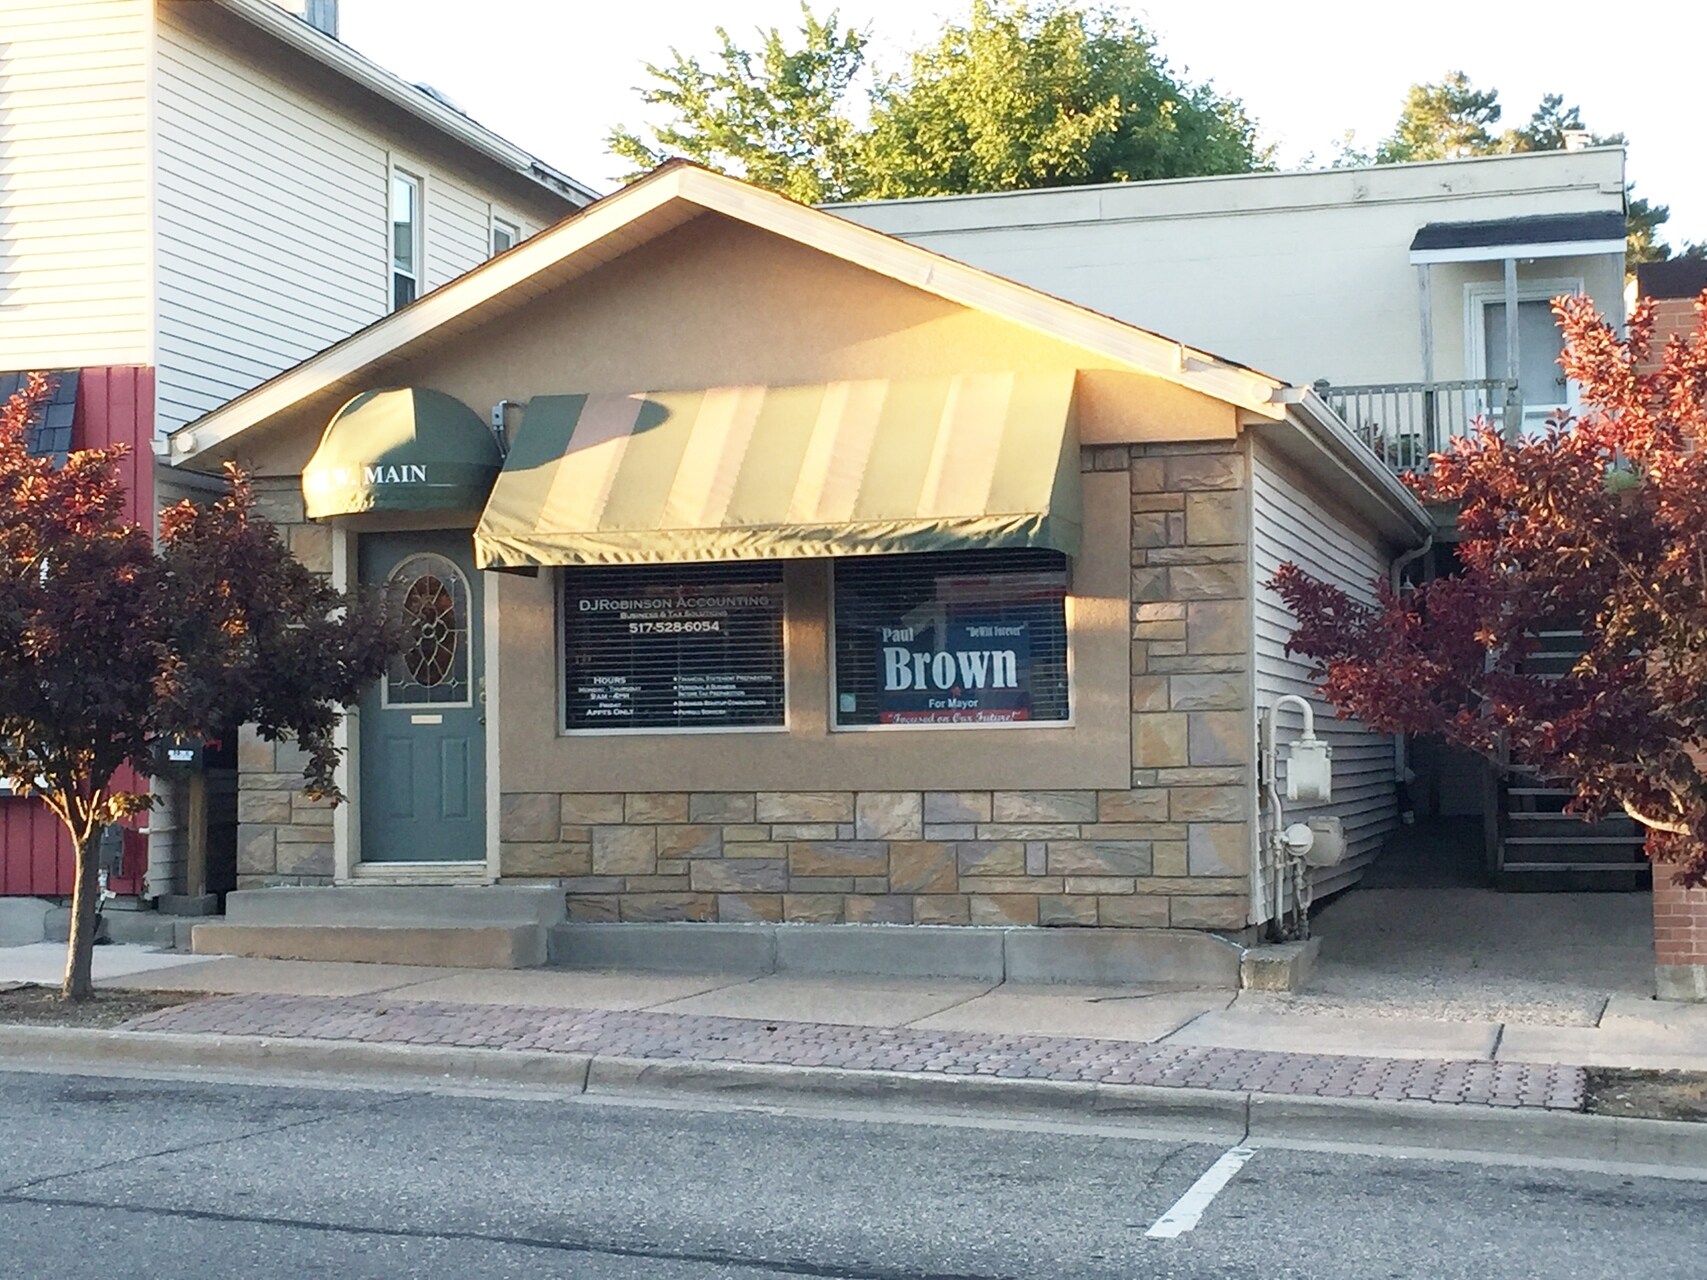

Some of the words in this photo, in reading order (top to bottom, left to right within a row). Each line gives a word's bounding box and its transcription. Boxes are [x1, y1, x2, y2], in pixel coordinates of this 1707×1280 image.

[363, 465, 427, 485] MAIN
[579, 598, 672, 611] DJROBINSON
[676, 596, 770, 608] ACCOUNTING
[628, 621, 720, 634] 517-528-6054
[882, 626, 914, 642] Paul
[883, 647, 1018, 690] Brown
[929, 698, 946, 708] For
[948, 698, 979, 710] Mayor
